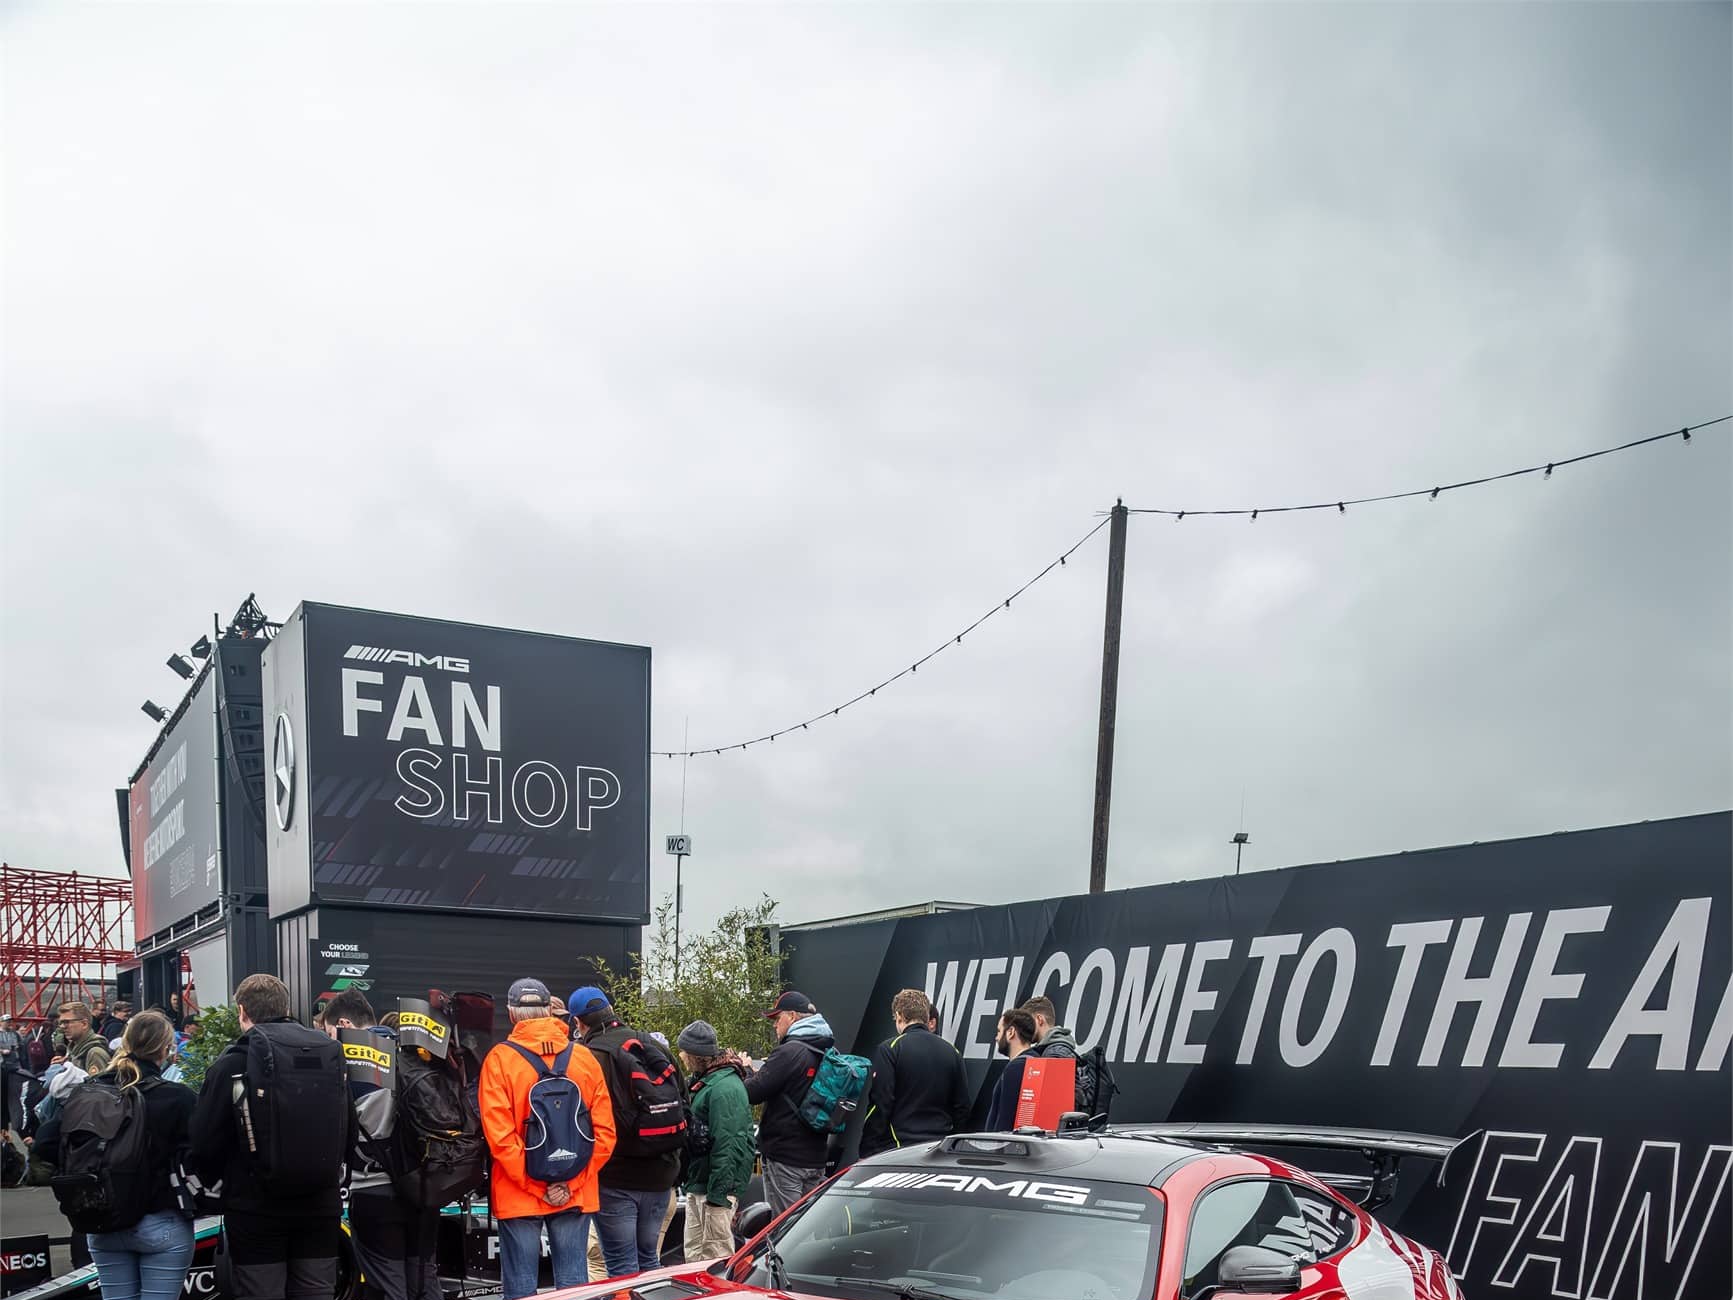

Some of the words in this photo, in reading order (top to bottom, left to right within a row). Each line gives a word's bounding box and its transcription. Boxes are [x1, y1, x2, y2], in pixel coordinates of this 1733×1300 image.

[386, 650, 470, 673] AMG
[342, 668, 501, 751] FAN
[395, 748, 621, 831] SHOP
[667, 838, 685, 851] WC
[1235, 927, 1358, 1068] TO
[1370, 905, 1613, 1068] THE
[400, 1014, 429, 1027] Giti
[345, 1047, 376, 1059] Giti
[916, 1173, 1091, 1205] AMG
